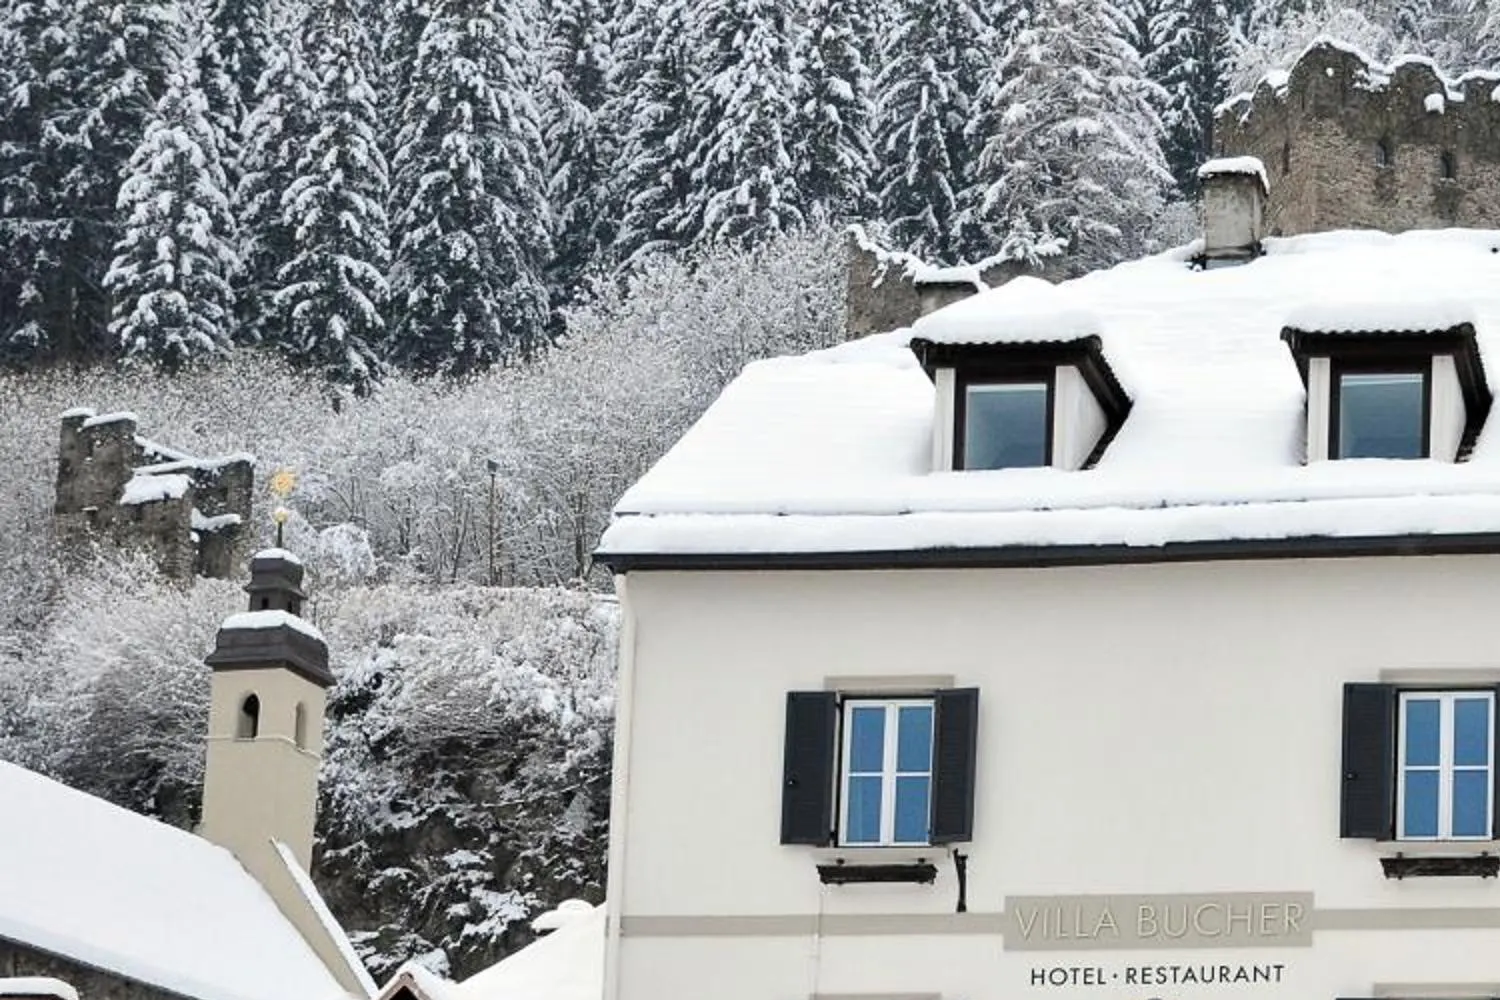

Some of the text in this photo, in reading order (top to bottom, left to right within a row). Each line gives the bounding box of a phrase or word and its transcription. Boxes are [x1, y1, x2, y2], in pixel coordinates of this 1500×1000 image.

[1014, 902, 1306, 941] VILLA BUCHER
[1030, 964, 1286, 987] HOTEL RESTAURANT
